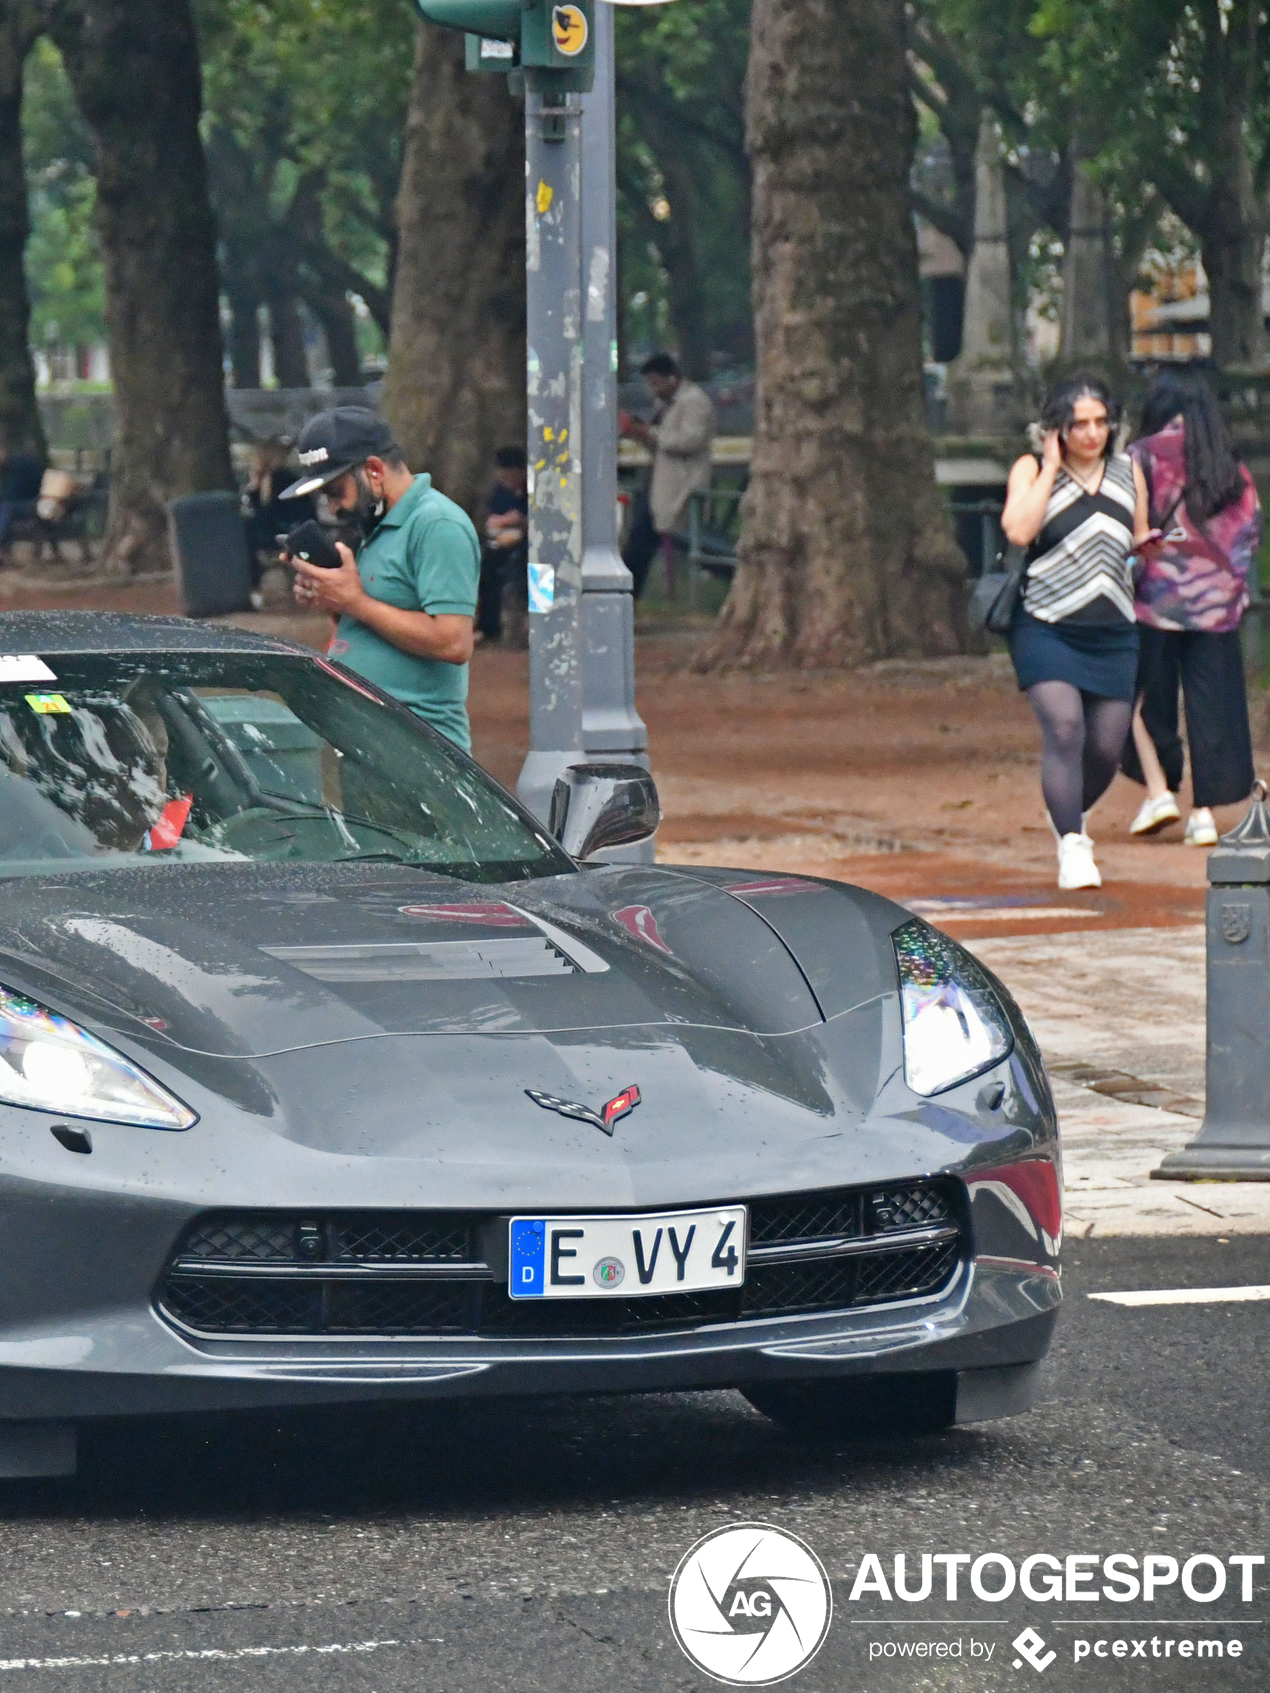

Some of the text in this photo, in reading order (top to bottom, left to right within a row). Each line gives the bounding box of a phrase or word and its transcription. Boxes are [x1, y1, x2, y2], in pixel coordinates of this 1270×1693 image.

[550, 1229, 585, 1285] E
[632, 1224, 696, 1284] VY
[711, 1220, 739, 1276] 4
[521, 1266, 535, 1283] D
